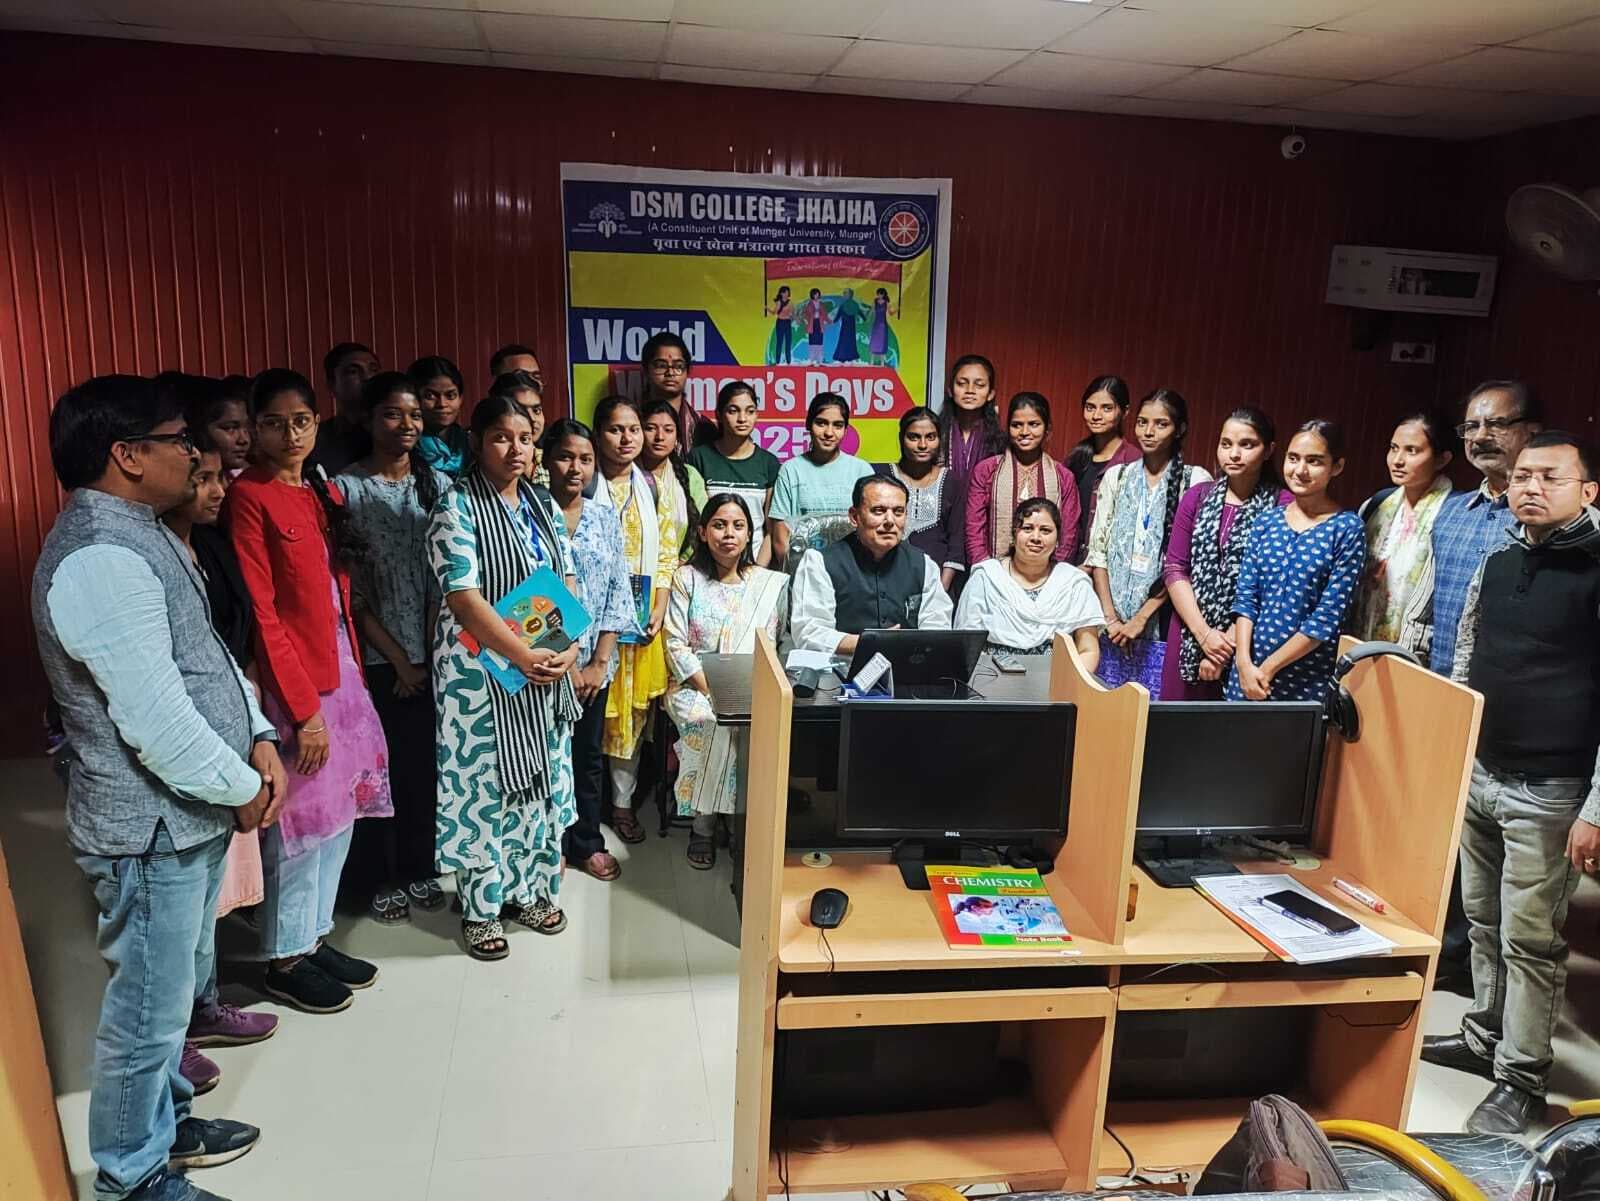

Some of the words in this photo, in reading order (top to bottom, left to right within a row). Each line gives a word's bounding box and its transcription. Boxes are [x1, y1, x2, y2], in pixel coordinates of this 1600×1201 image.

[630, 190, 684, 218] DSM
[690, 193, 791, 224] COLLEGE,
[796, 198, 877, 226] JHAJHA
[661, 223, 716, 234] Constituent
[719, 225, 738, 235] Unit
[740, 226, 750, 235] of
[752, 226, 786, 238] Munger
[788, 227, 837, 240] University,
[839, 229, 876, 240] Munger)
[682, 236, 703, 250] एवं
[788, 242, 821, 254] भारत
[823, 244, 866, 255] सरकार
[943, 877, 1033, 888] CHEMISTRY
